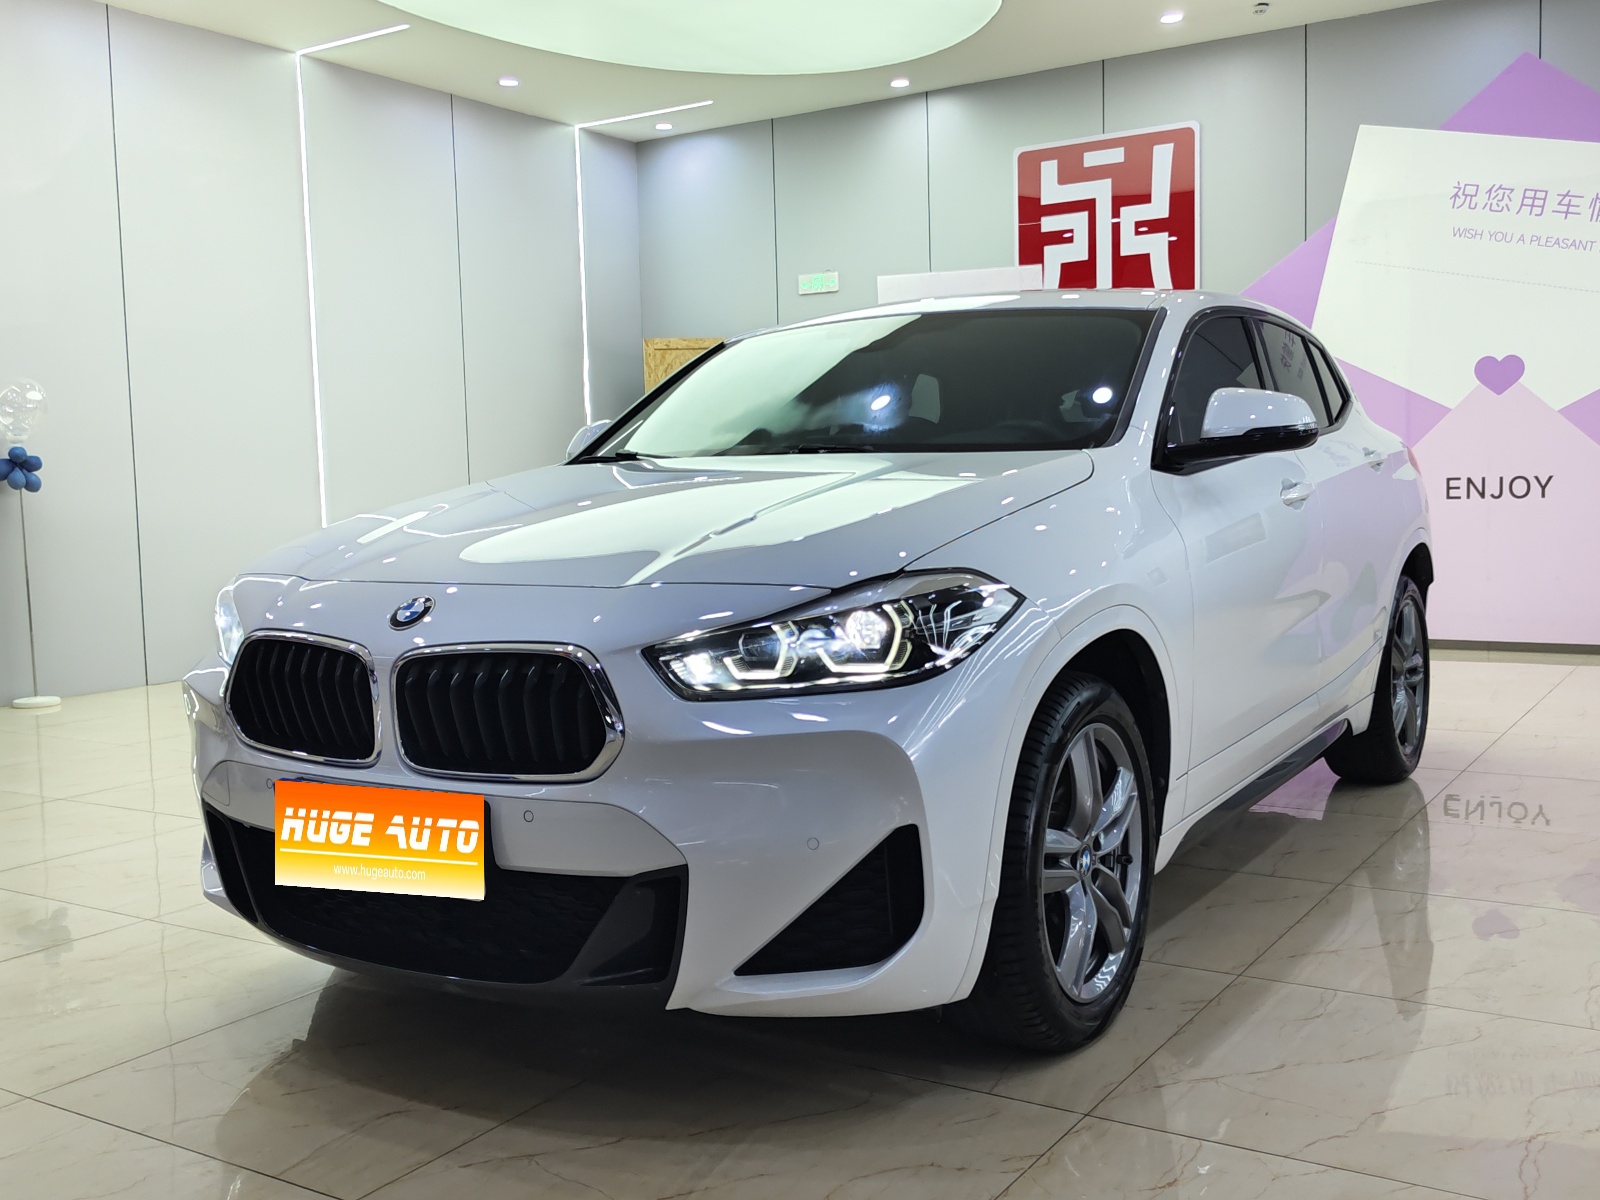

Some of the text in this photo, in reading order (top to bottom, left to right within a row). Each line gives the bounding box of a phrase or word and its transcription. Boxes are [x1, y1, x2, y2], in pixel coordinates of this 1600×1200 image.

[1452, 226, 1597, 252] WISH YOU A PLEASANT
[1445, 475, 1554, 500] ENJOY
